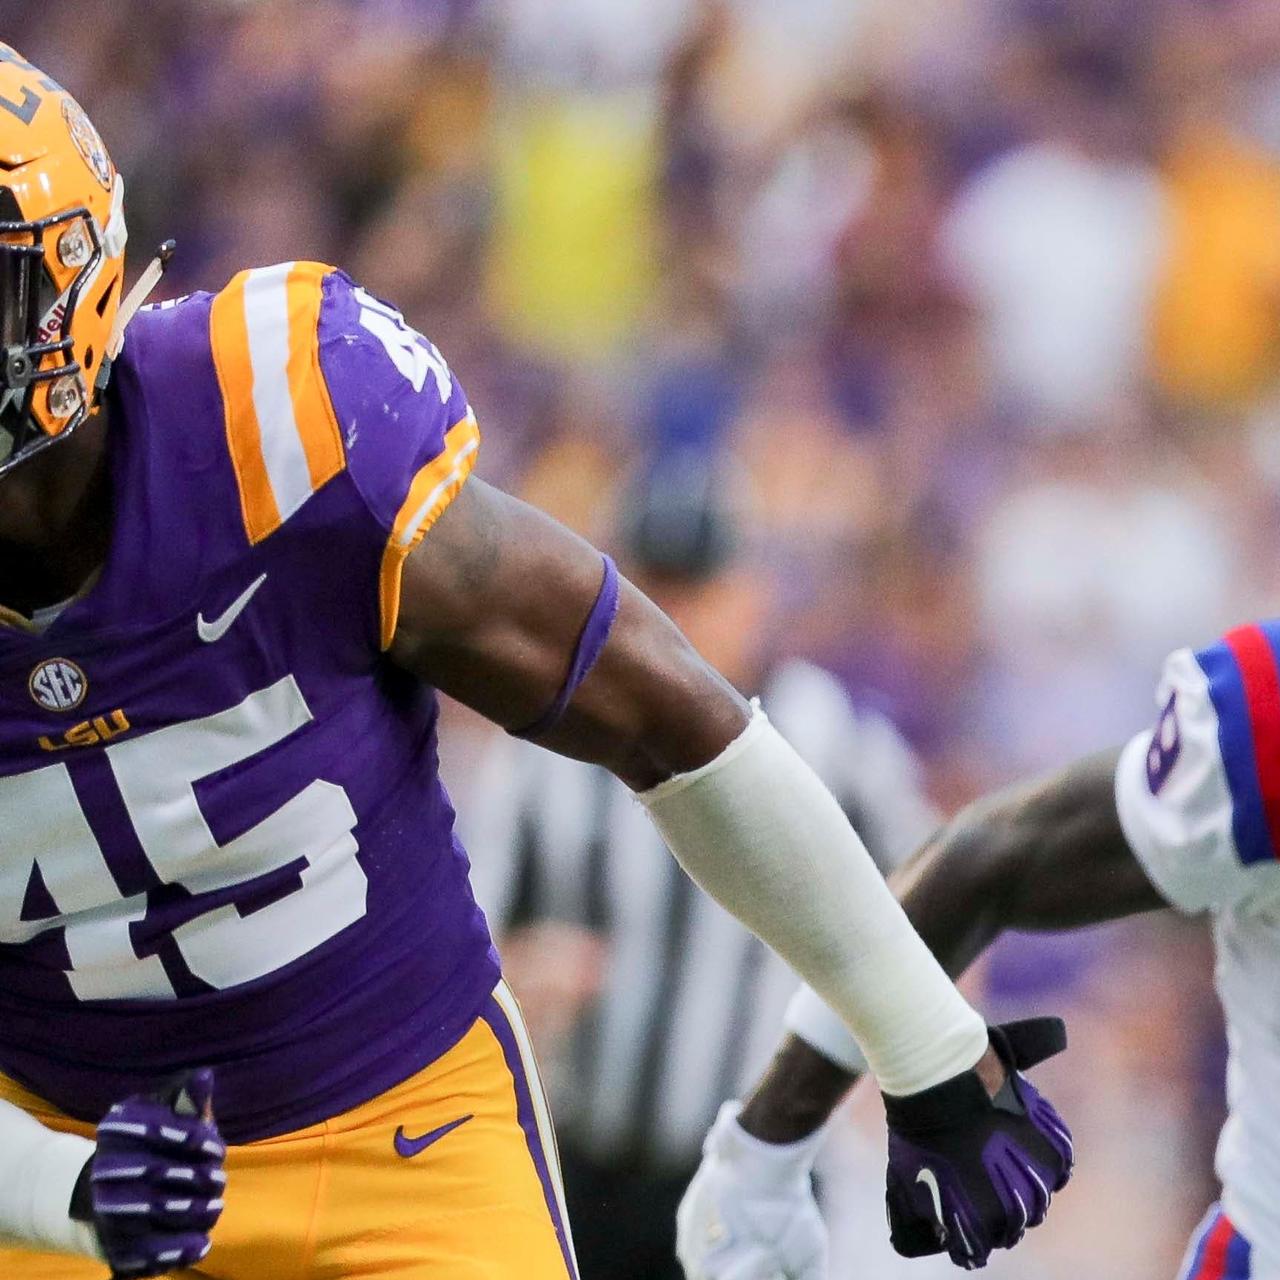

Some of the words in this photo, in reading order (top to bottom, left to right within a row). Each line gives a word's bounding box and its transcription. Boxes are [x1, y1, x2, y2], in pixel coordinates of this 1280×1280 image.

[32, 663, 82, 708] SEC
[38, 709, 130, 751] LSU
[0, 673, 369, 1002] 45
